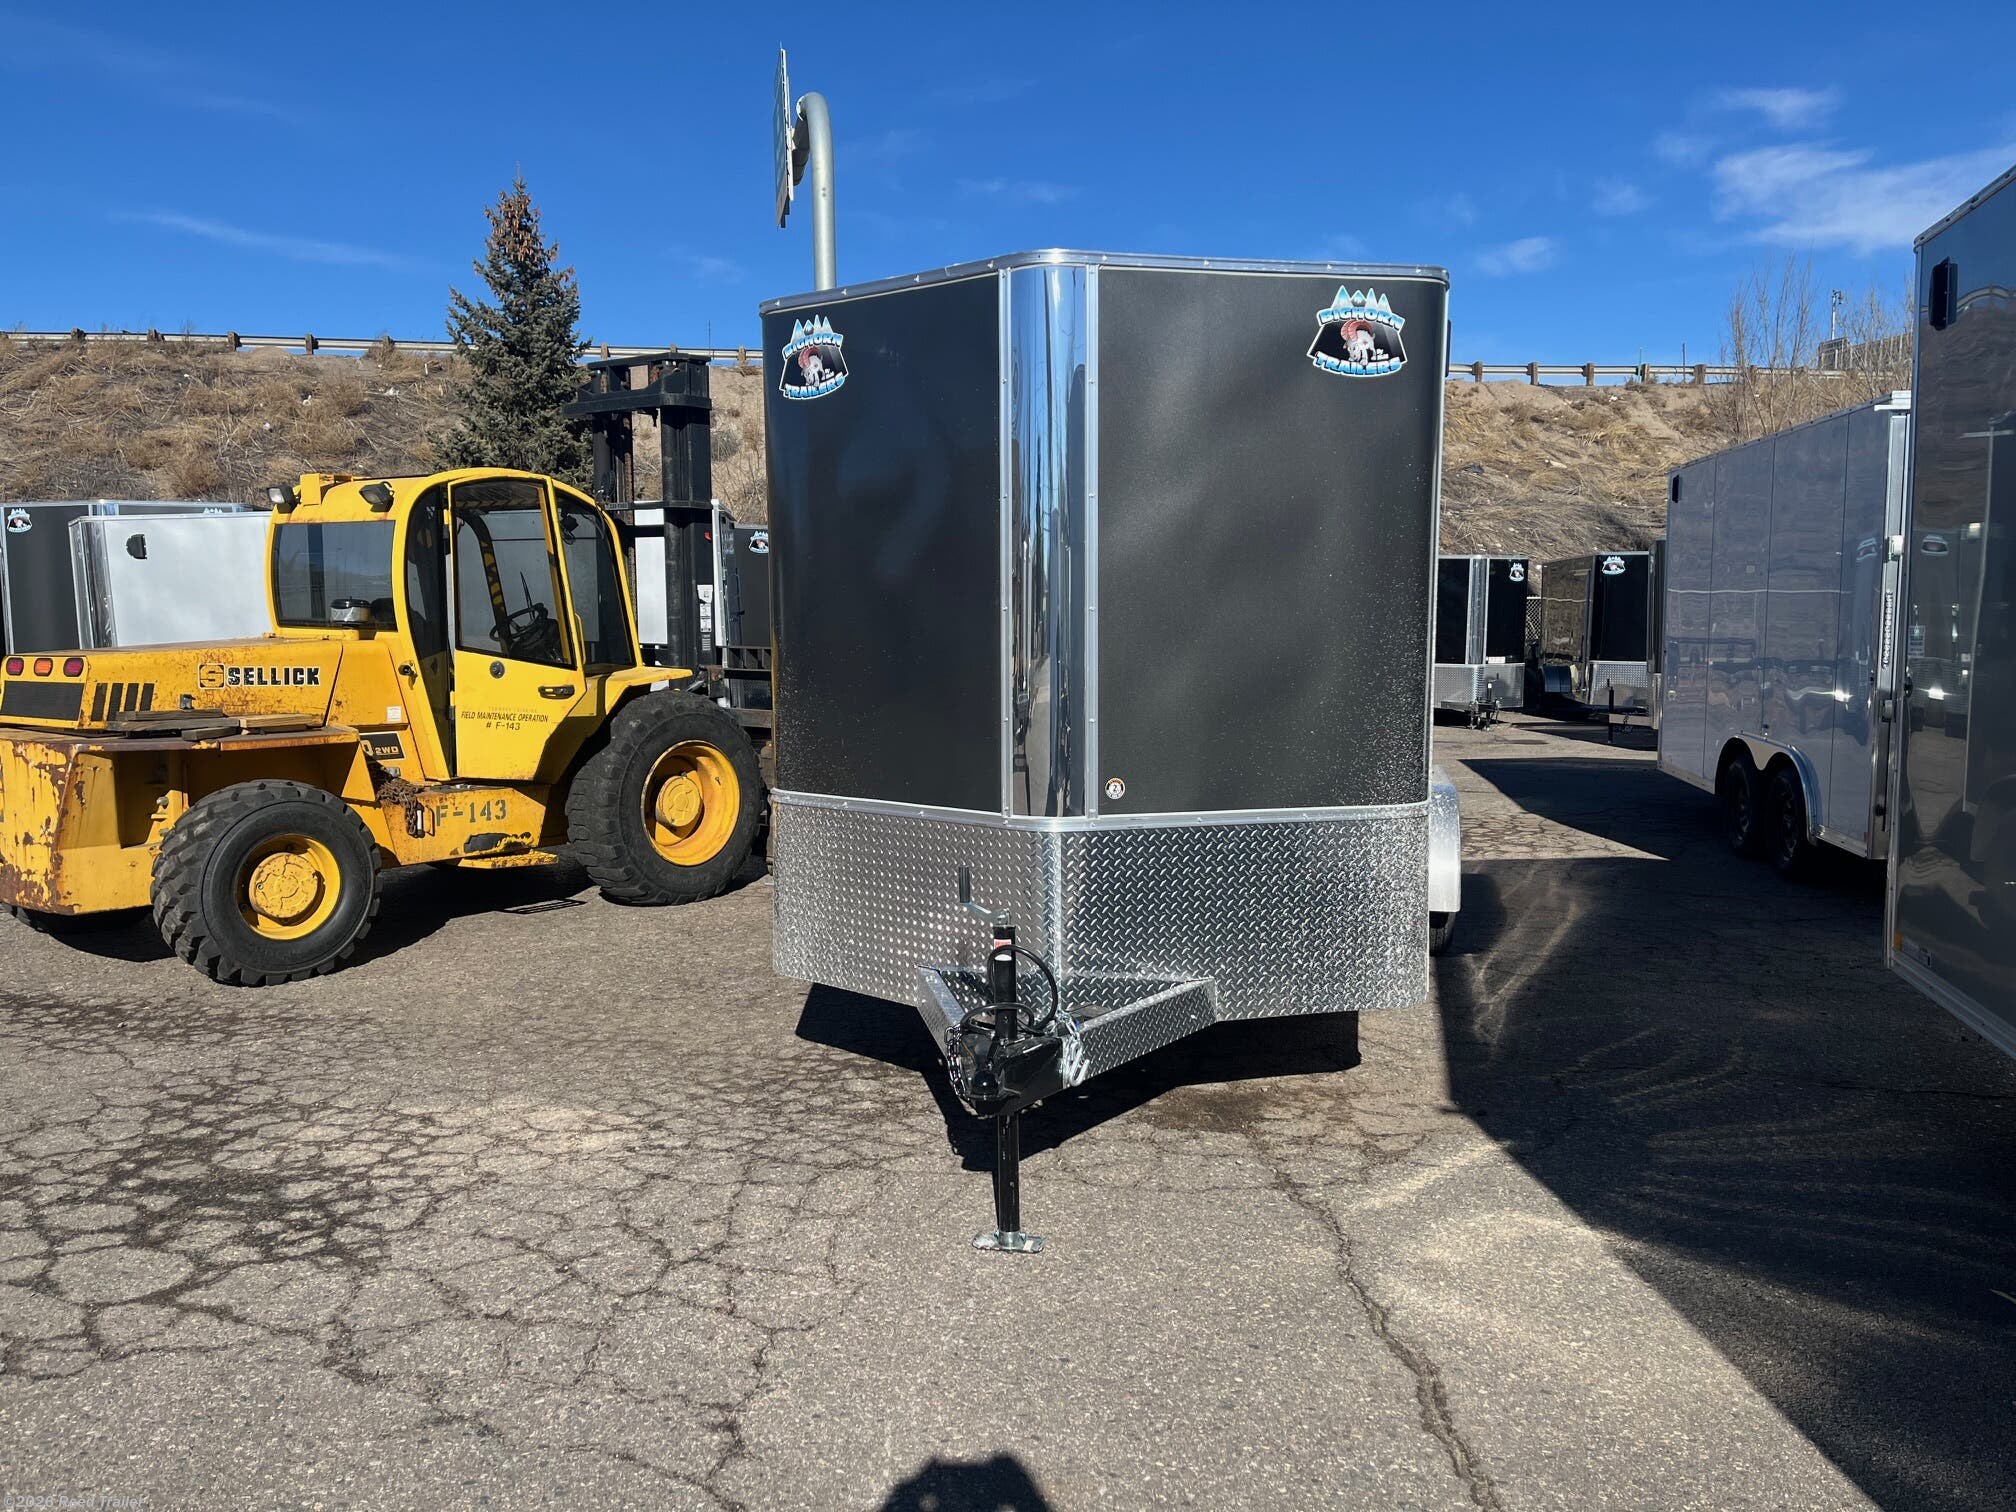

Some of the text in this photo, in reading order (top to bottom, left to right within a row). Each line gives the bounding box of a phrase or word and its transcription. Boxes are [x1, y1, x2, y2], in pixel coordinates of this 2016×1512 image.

[1319, 306, 1405, 331] BIGHORN
[784, 332, 843, 359] BIGHORN
[1315, 351, 1402, 376] TRAILERS
[784, 371, 846, 398] TRAILERS
[227, 666, 321, 687] SELLICK
[461, 711, 549, 723] FIELD MAINTENANCE OPERATION
[495, 722, 521, 730] F-143
[374, 745, 399, 756] 2WD
[435, 799, 507, 827] F-143
